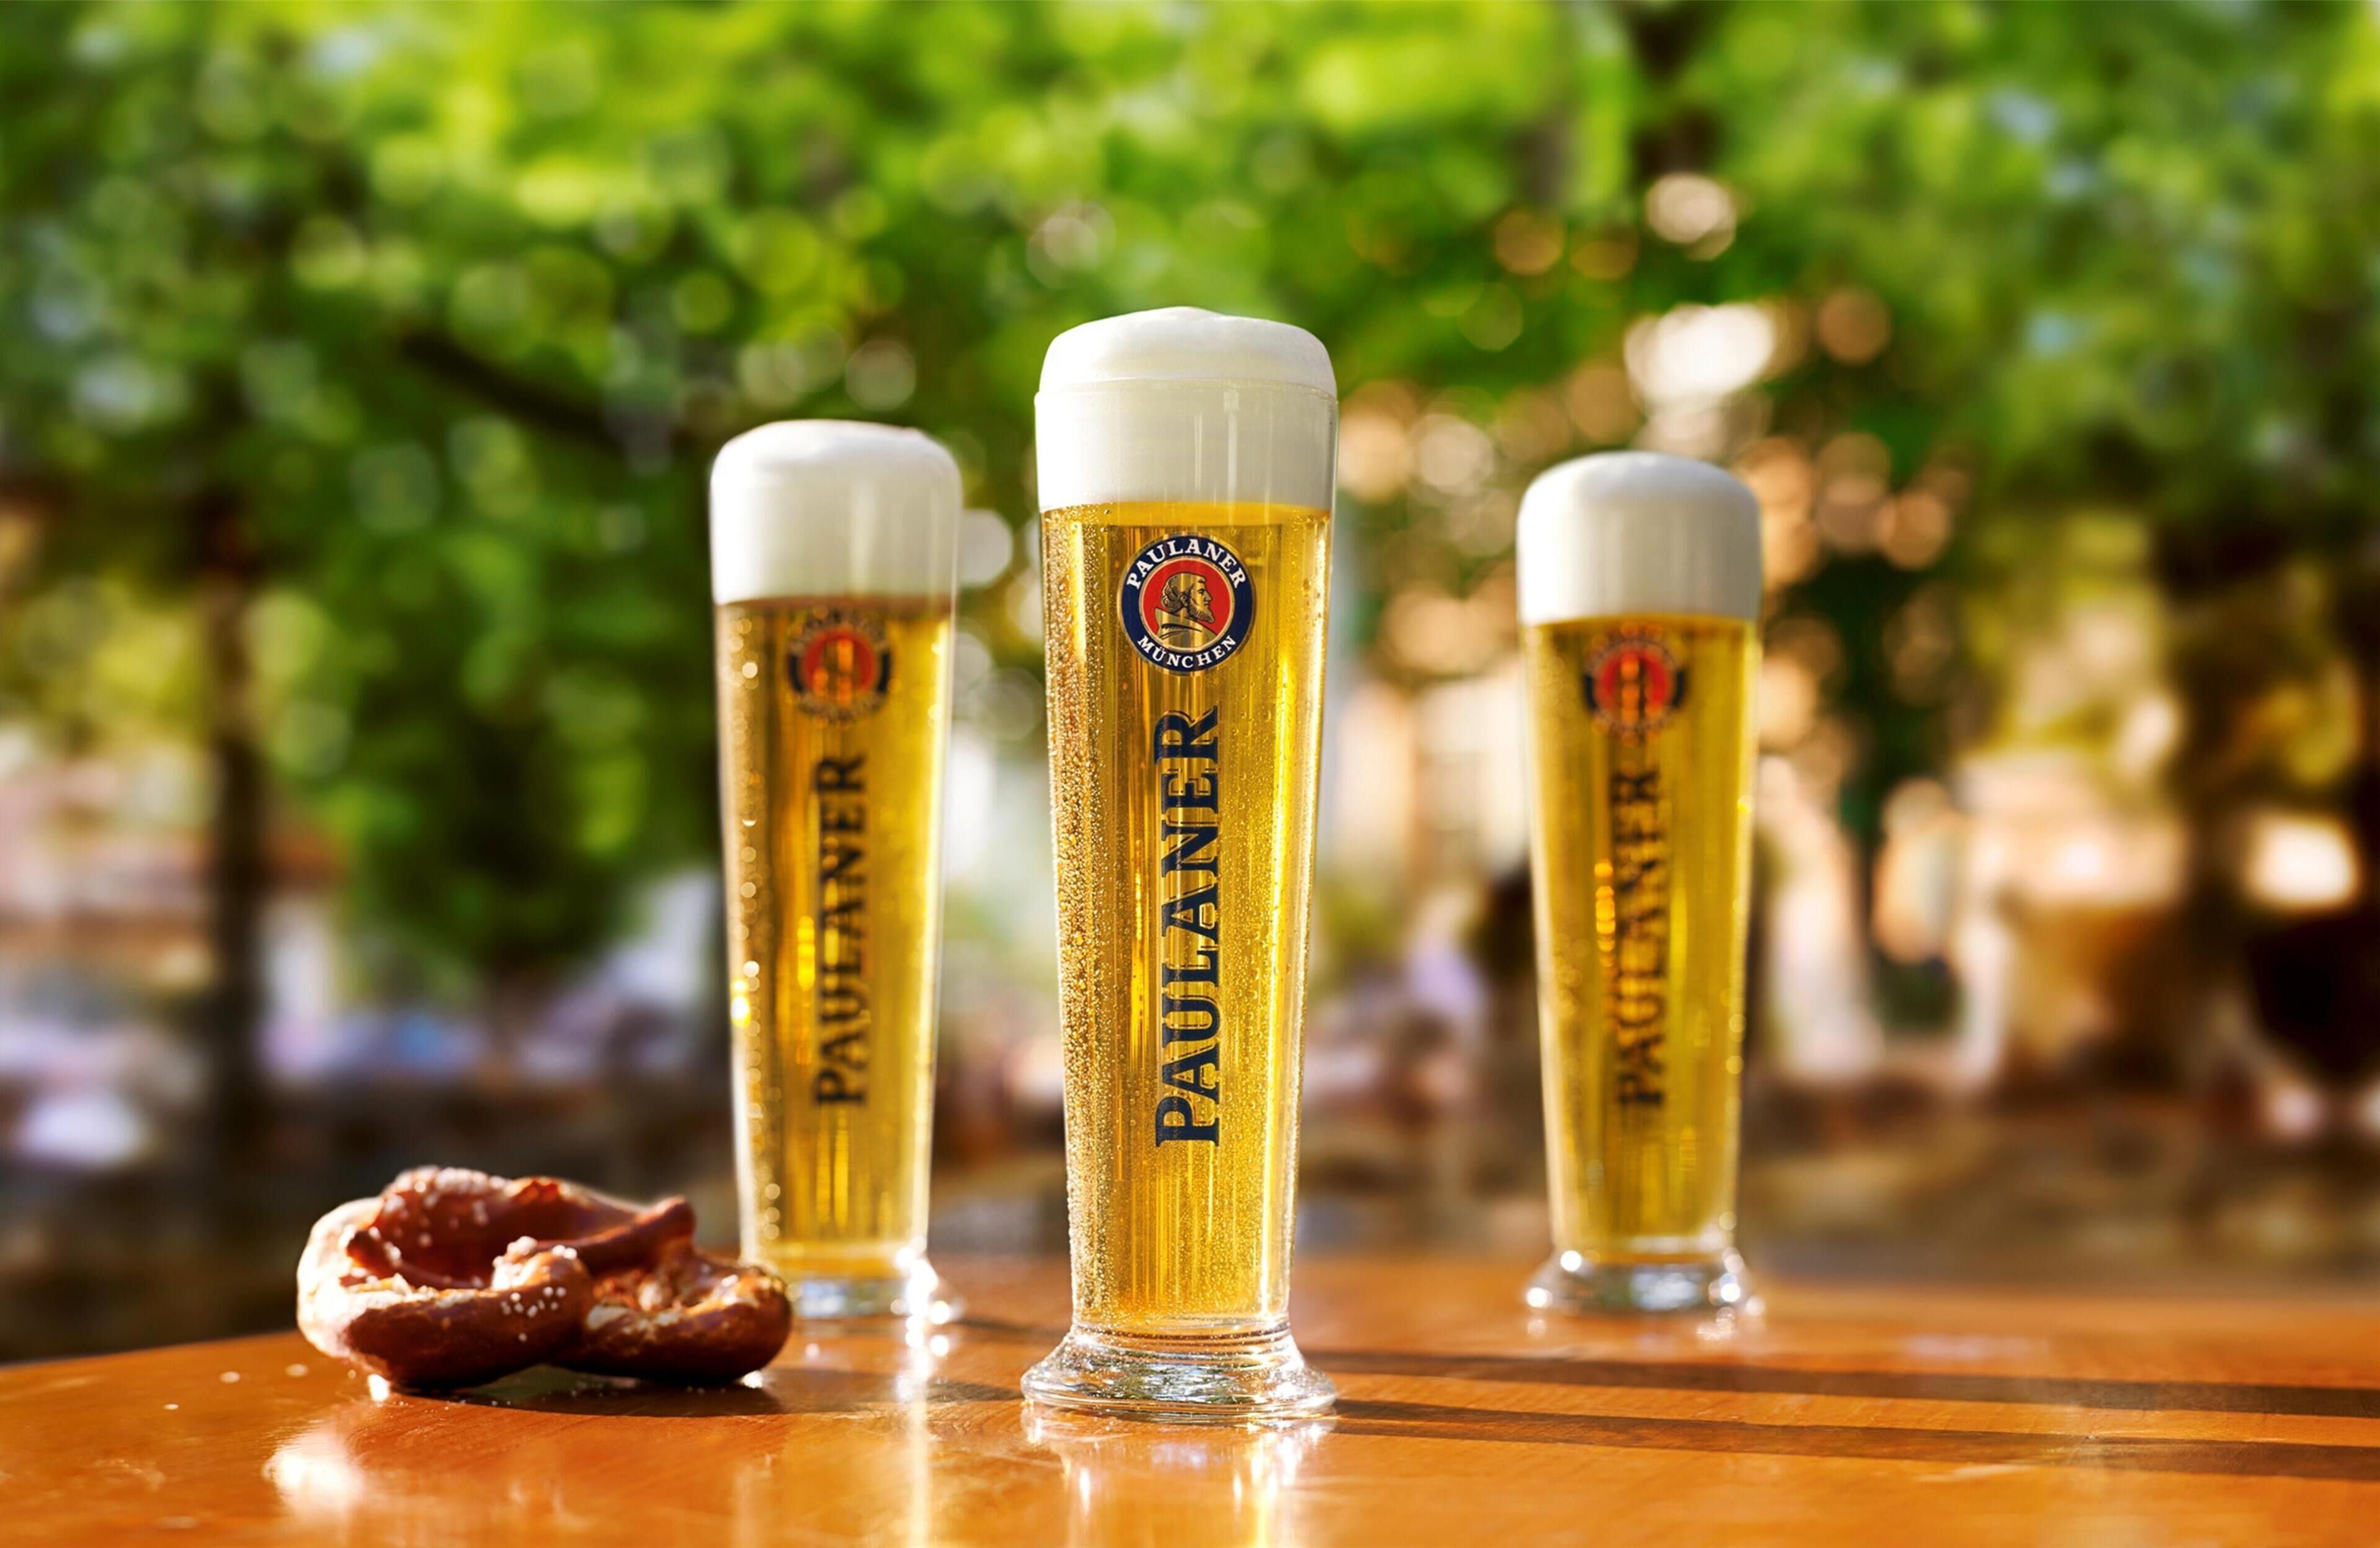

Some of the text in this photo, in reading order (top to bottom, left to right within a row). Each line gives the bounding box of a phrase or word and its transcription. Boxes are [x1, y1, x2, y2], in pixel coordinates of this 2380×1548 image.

[1126, 539, 1246, 589] PAULANER
[1138, 635, 1236, 668] MÜNCHEN
[815, 754, 866, 1104] PAULANER
[1154, 706, 1219, 1147] PAULANER
